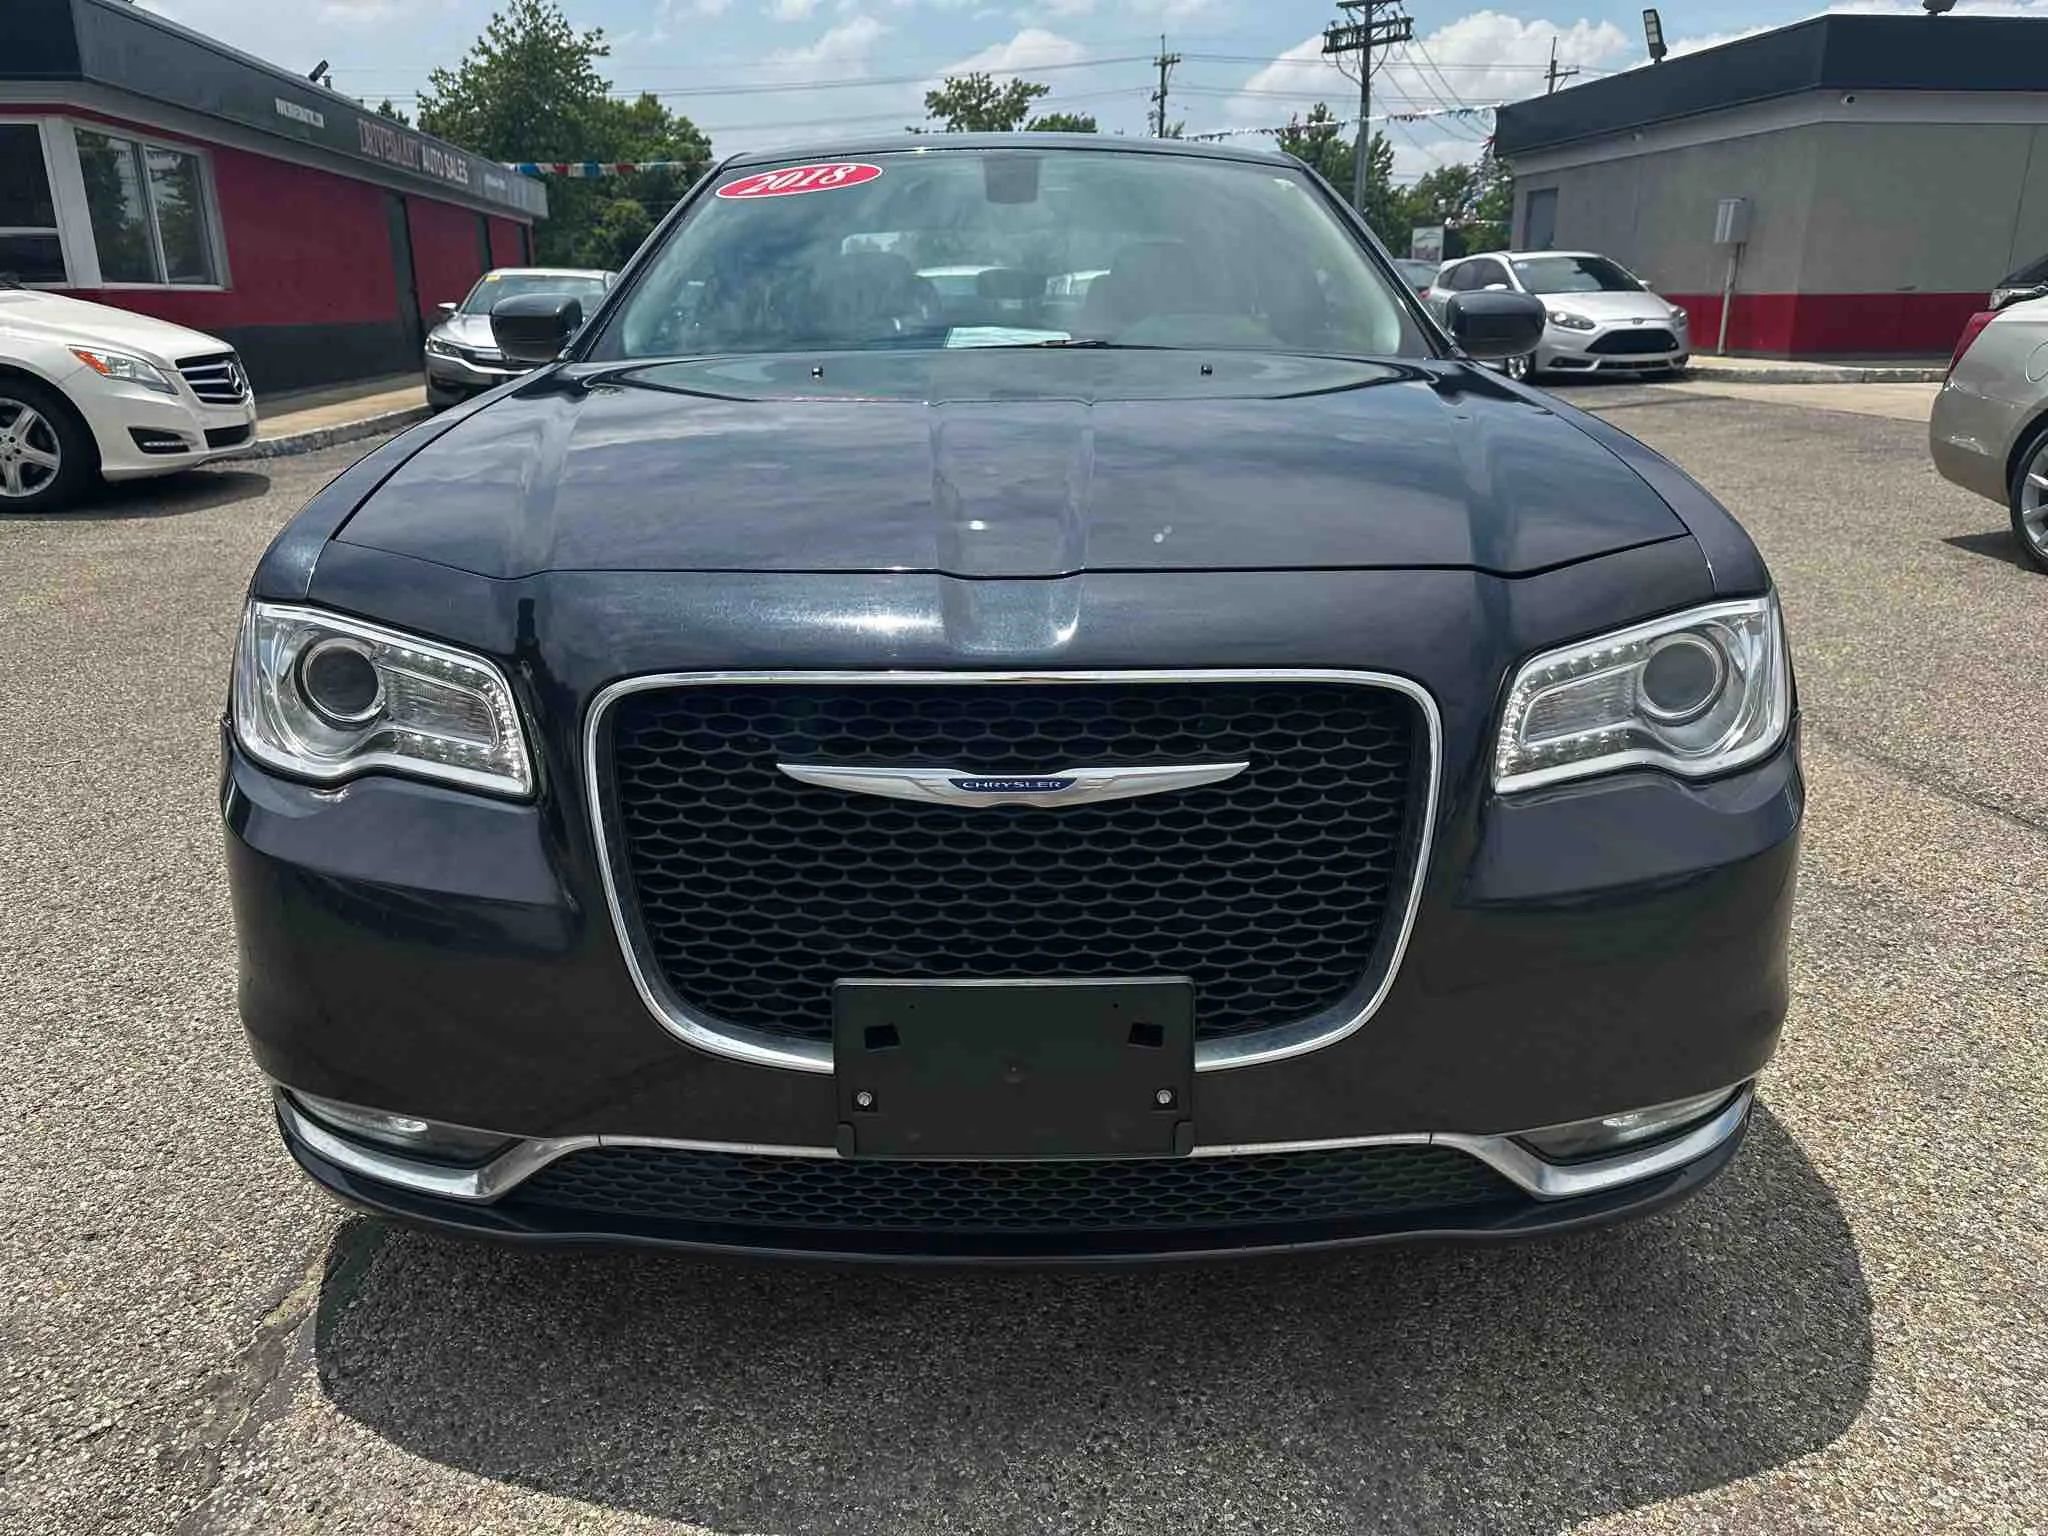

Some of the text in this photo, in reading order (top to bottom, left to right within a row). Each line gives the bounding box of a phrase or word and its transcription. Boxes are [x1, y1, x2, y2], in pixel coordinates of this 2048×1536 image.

[421, 143, 444, 178] AUTO
[444, 151, 469, 185] SALES
[736, 165, 857, 196] 2018
[962, 781, 1062, 789] CHRYSLER
